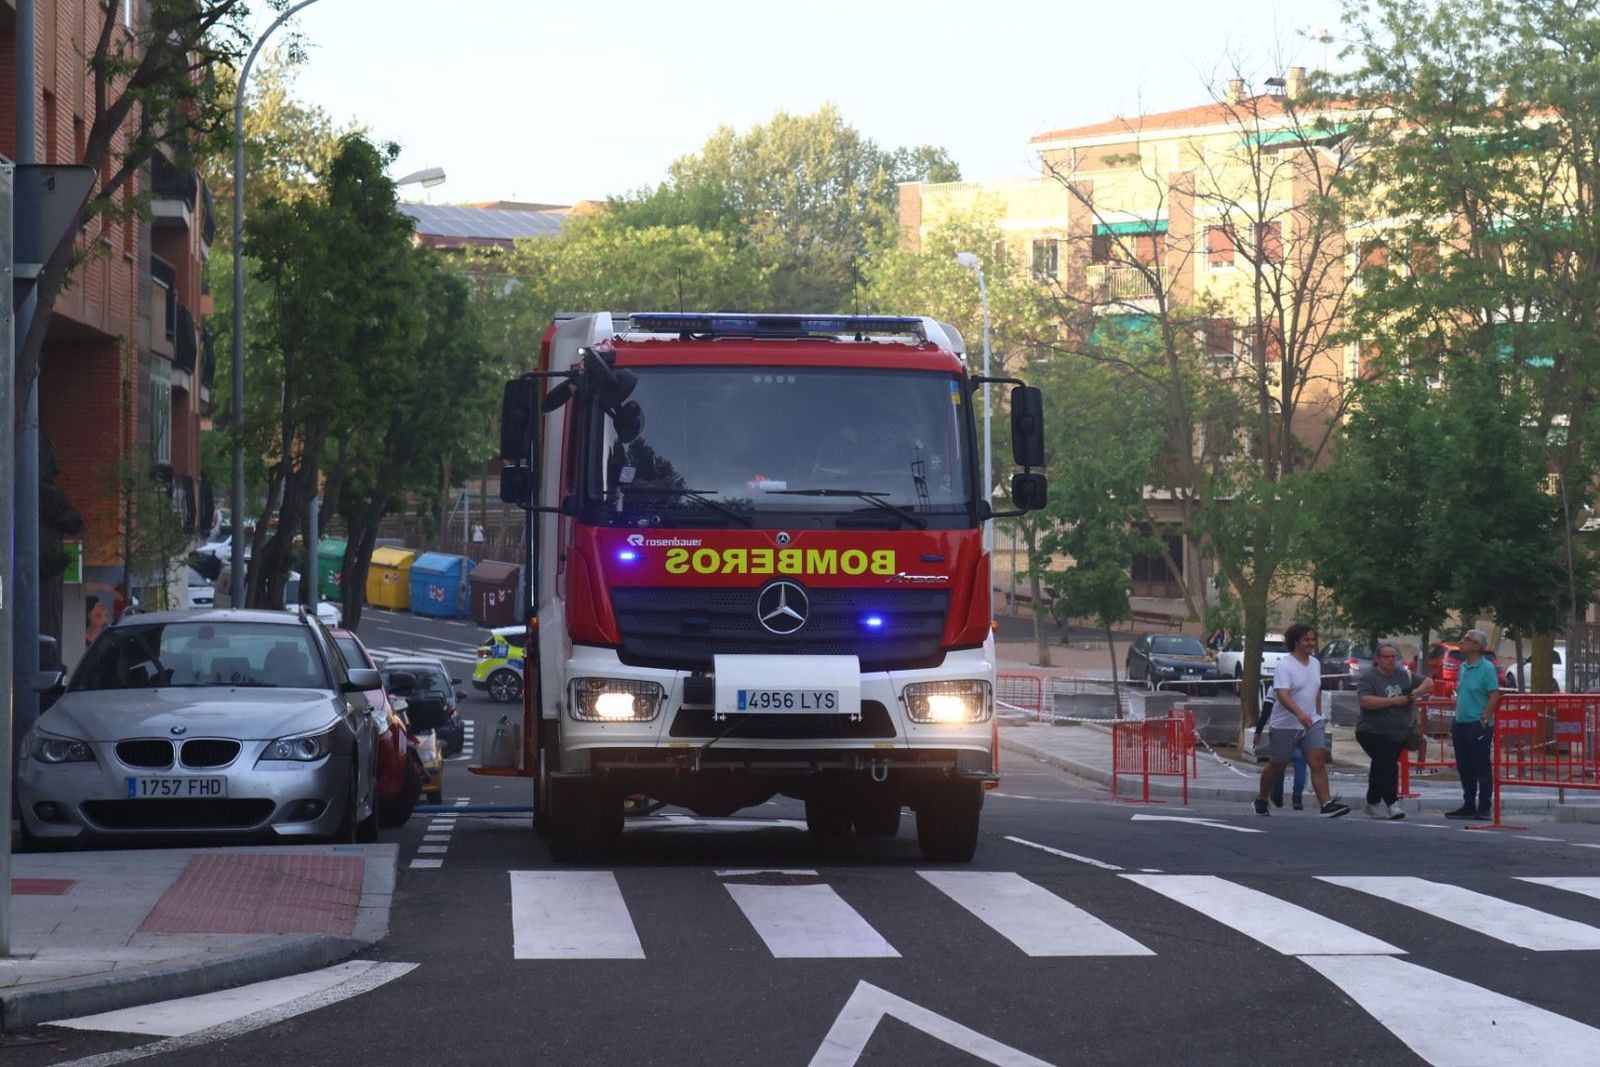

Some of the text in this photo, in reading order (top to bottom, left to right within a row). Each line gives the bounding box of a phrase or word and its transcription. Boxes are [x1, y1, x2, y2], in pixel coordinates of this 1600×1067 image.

[645, 536, 703, 547] rosenbauer
[749, 692, 835, 709] 4956 LYS
[141, 780, 221, 796] 1757 FHD
